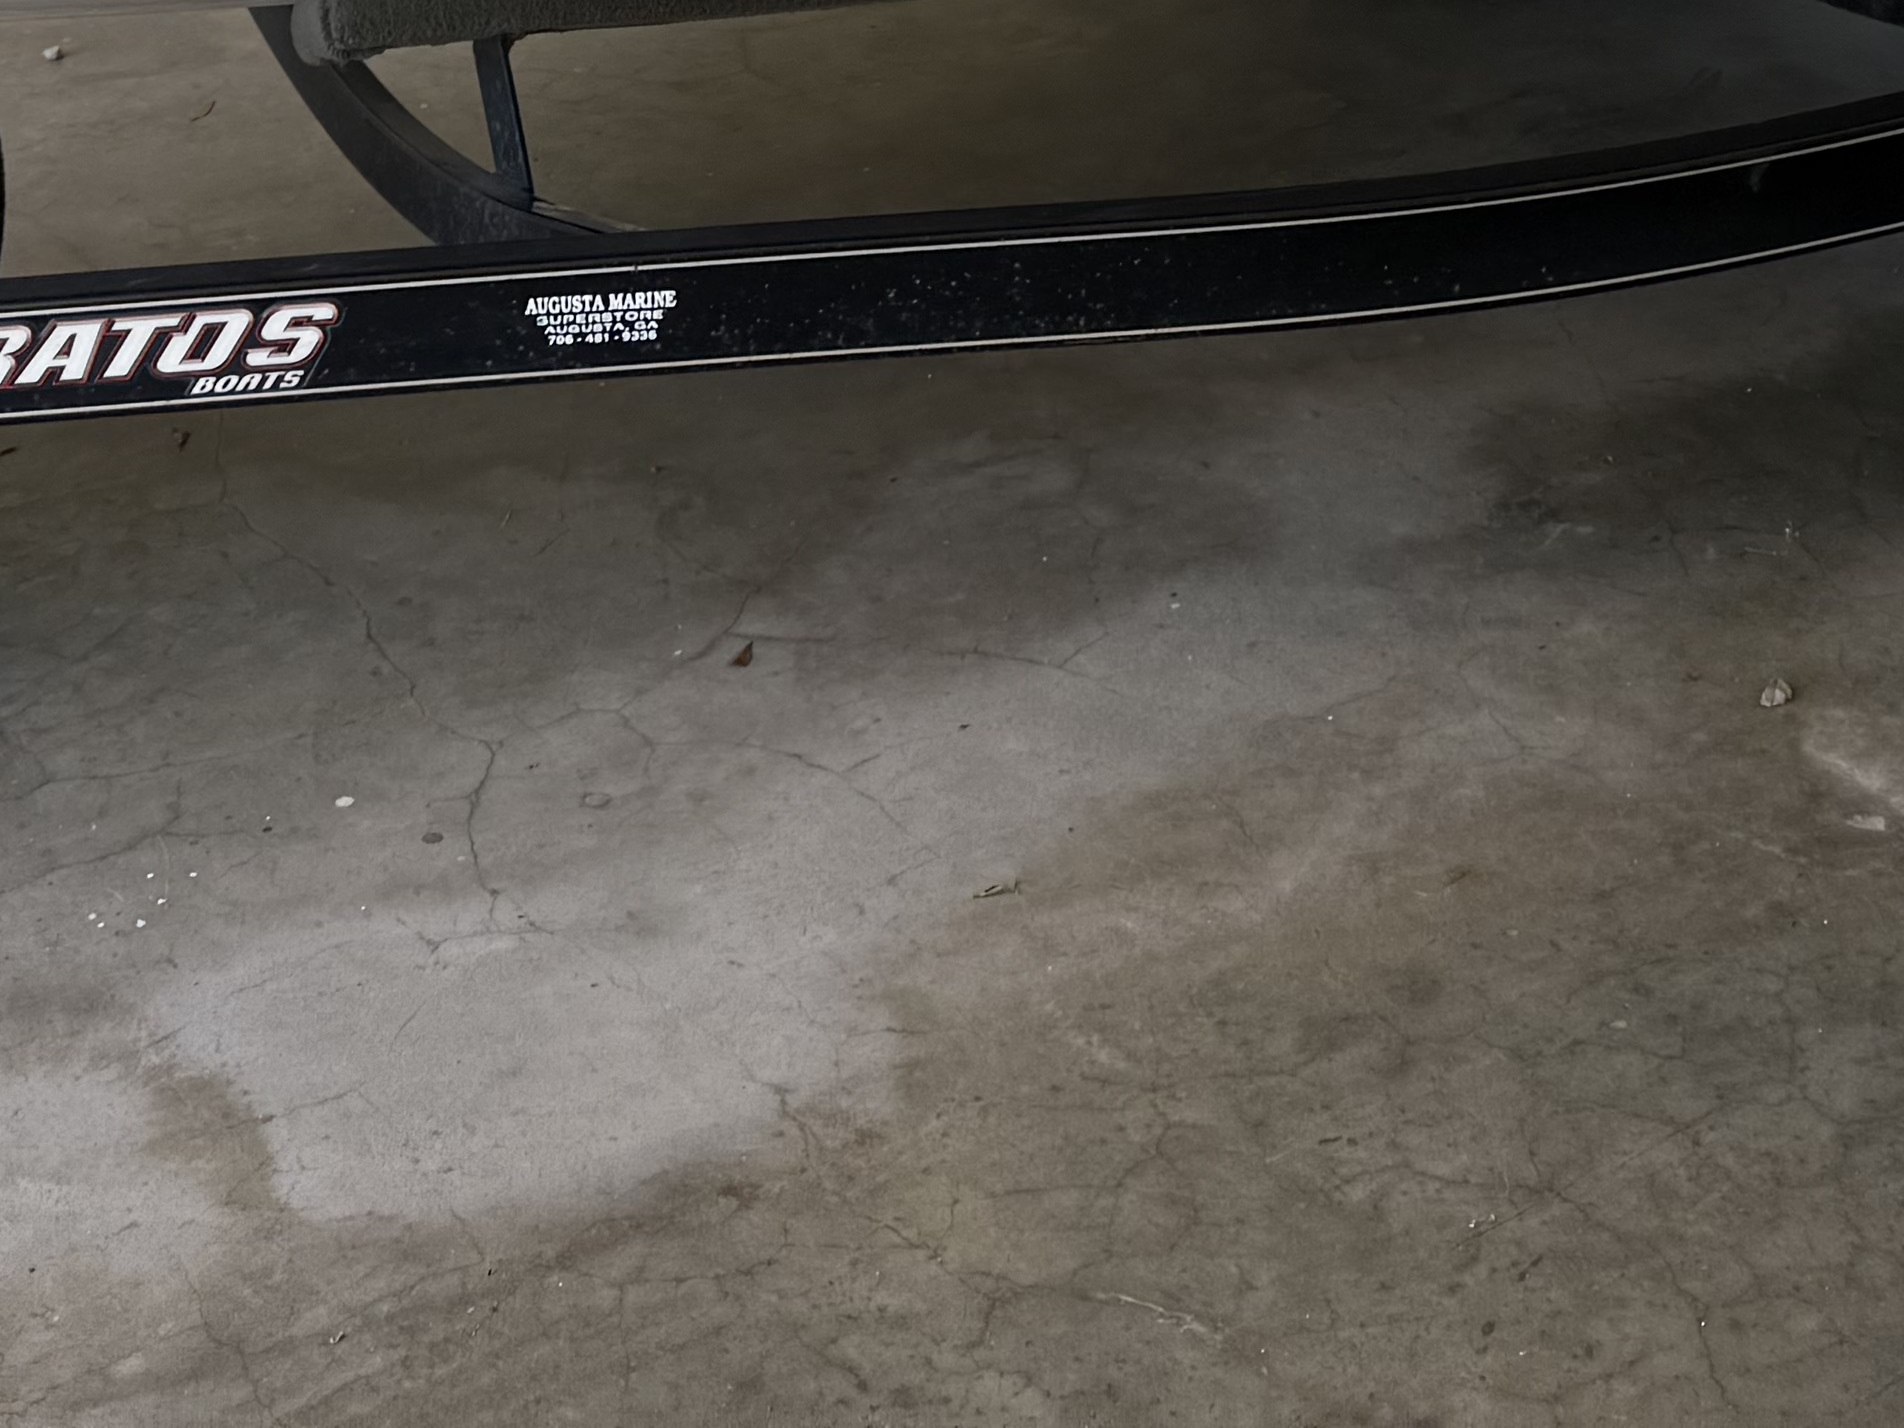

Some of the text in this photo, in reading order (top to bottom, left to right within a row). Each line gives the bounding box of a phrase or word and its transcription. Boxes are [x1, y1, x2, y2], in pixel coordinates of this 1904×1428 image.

[524, 290, 678, 316] AUGUSTA MARINE
[536, 309, 664, 326] SUPERSTORE
[544, 320, 659, 335] AUGUSTA, GA
[192, 369, 305, 396] BOATS
